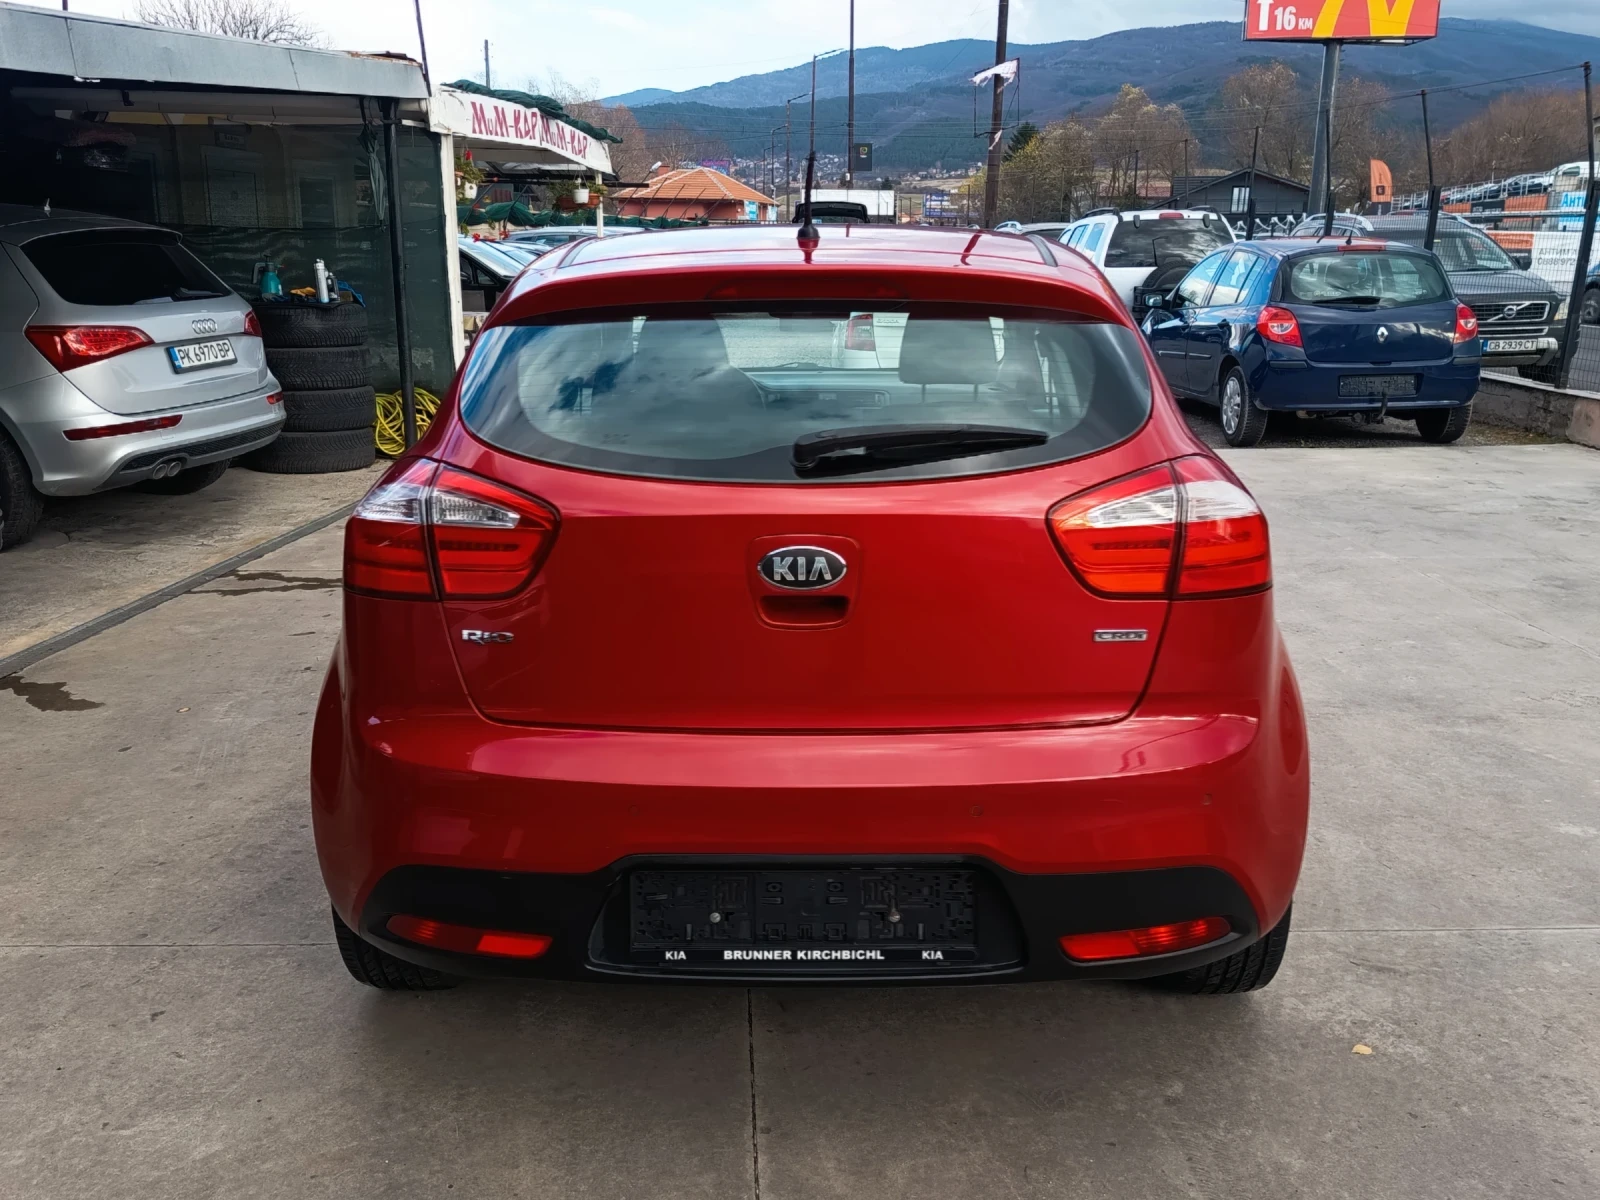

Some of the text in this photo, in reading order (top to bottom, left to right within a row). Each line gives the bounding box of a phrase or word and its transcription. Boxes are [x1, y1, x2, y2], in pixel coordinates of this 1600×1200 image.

[1274, 6, 1296, 30] 16
[193, 344, 218, 362] 6970
[1488, 340, 1536, 350] CB 2939 CT
[772, 556, 832, 581] KIA
[665, 950, 944, 960] KIA BRUNNER KIRCHBICHL KIA
